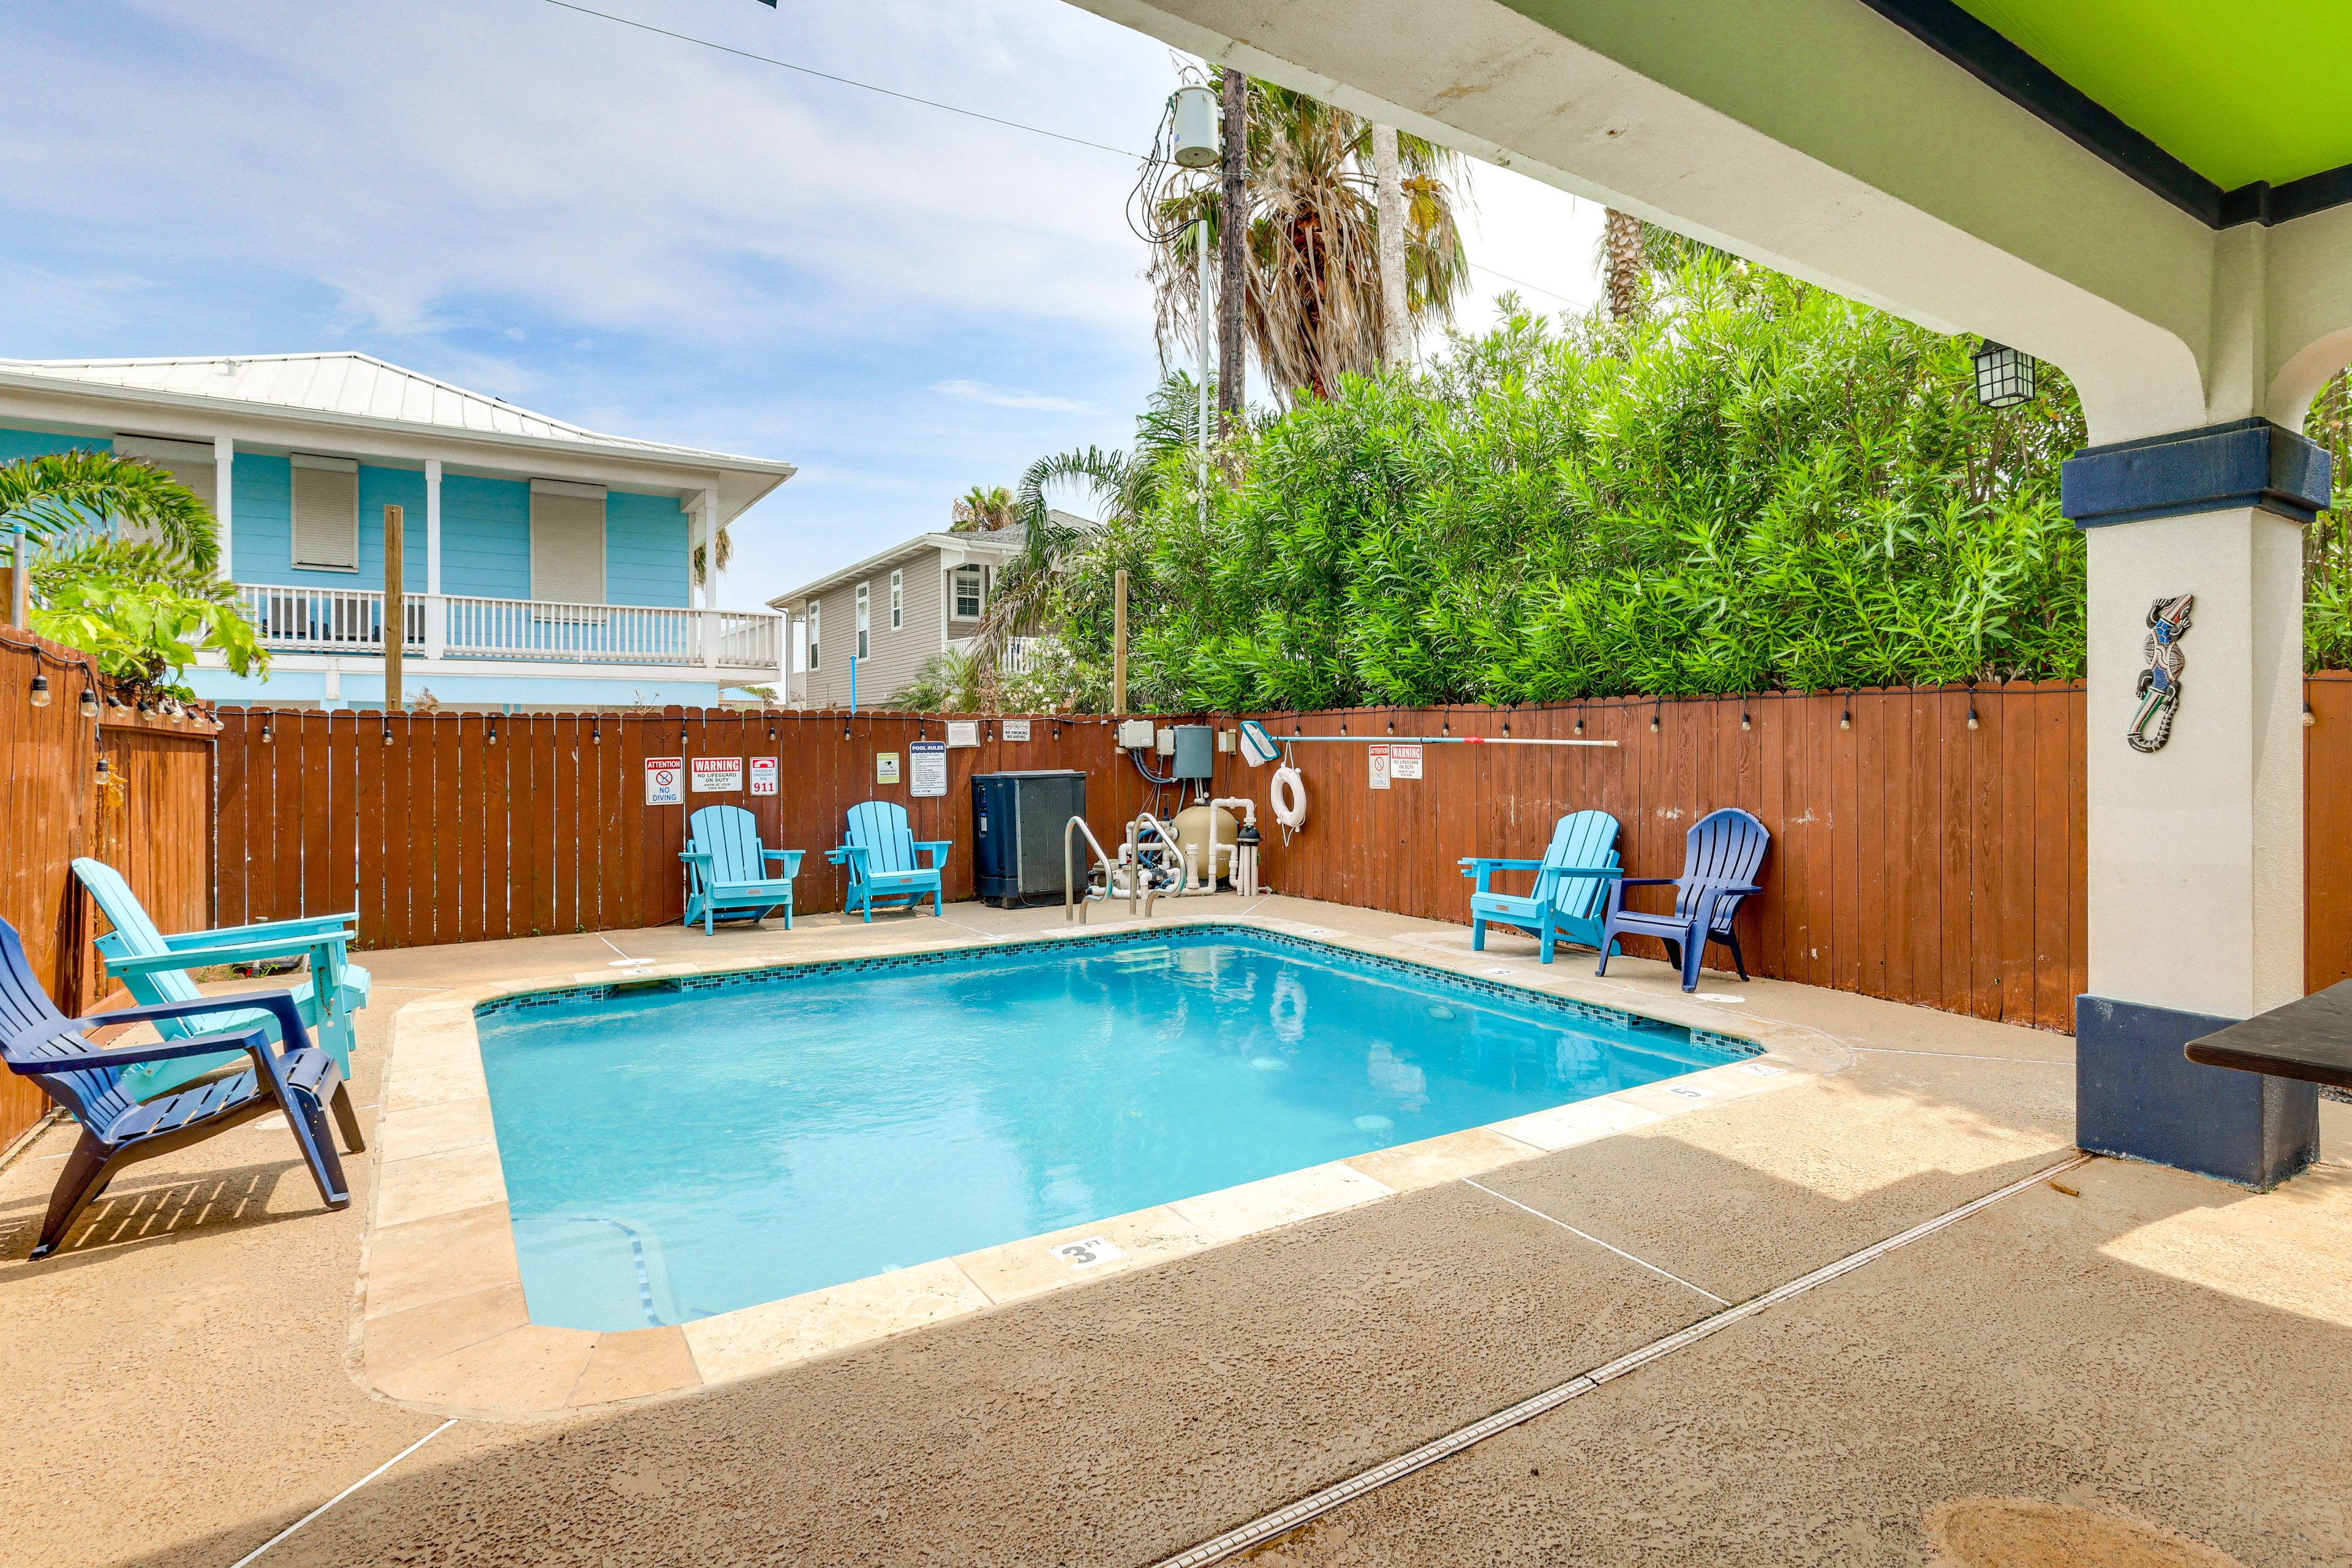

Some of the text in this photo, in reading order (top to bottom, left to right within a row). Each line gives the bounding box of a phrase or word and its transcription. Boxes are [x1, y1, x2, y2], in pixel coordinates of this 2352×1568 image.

[1393, 747, 1420, 758] WARNING
[695, 760, 739, 771] WARNING
[754, 782, 774, 792] 911
[1671, 1088, 1701, 1097] 5
[1062, 1246, 1096, 1264] 3
